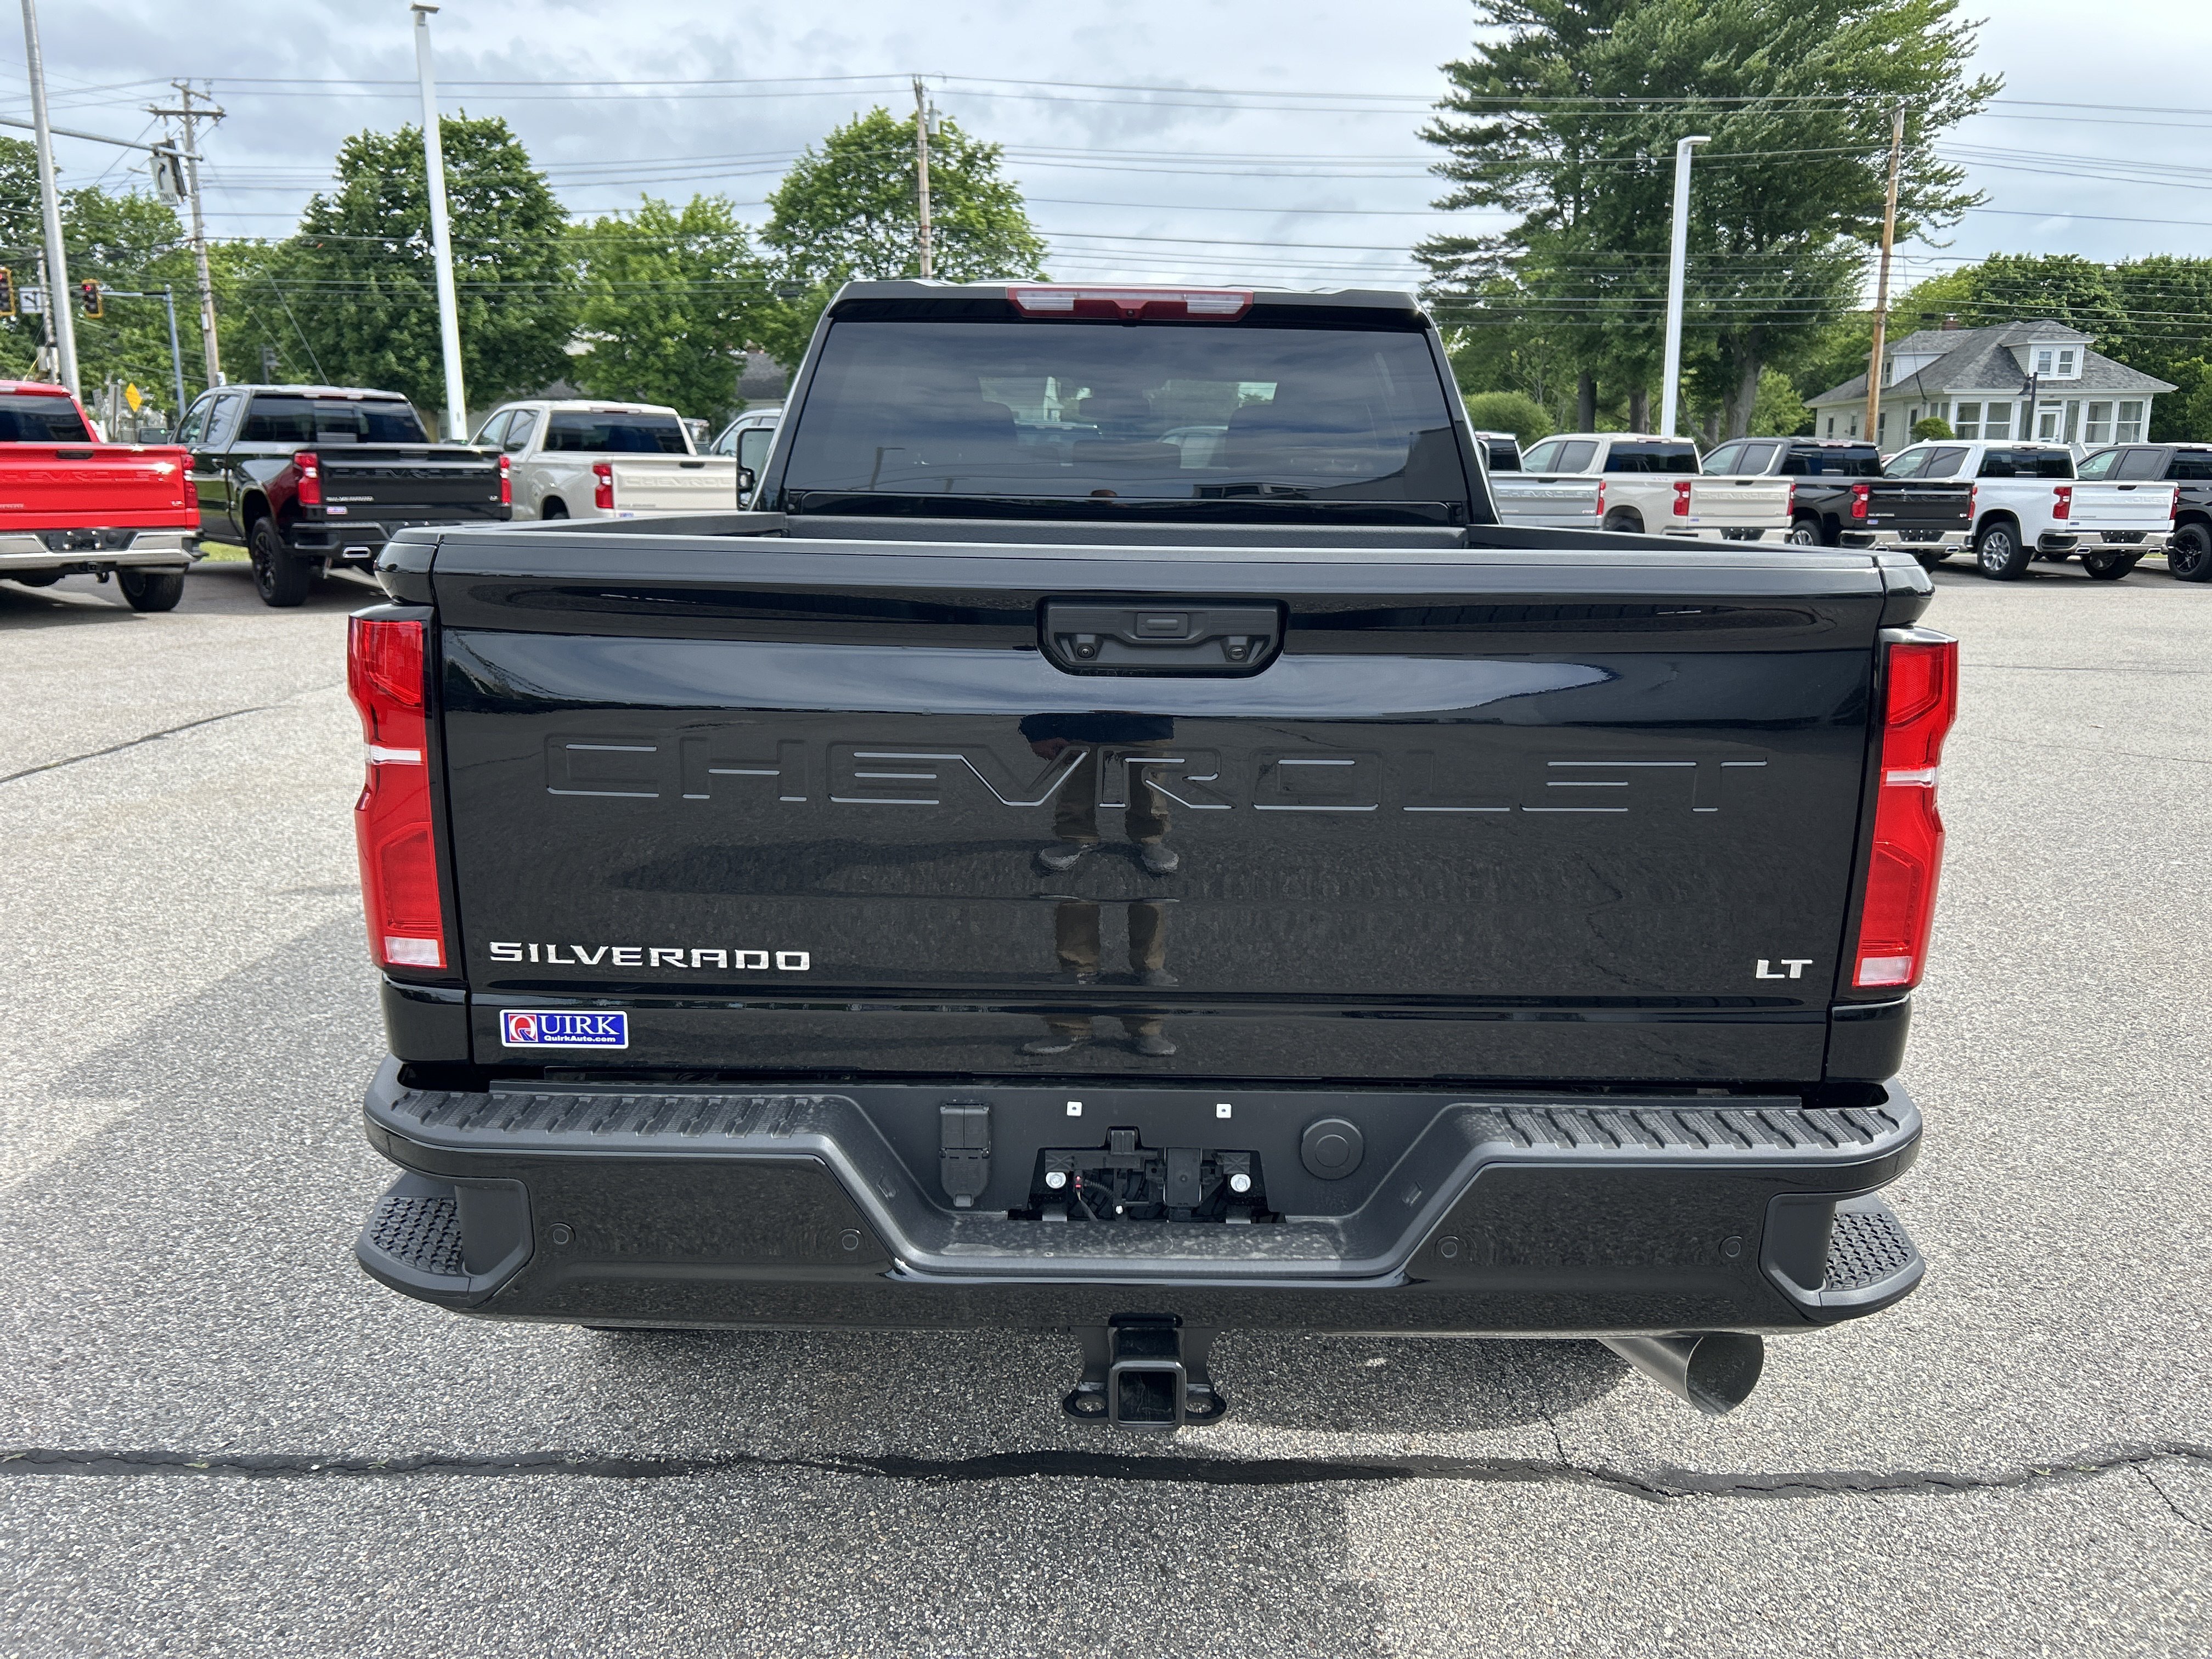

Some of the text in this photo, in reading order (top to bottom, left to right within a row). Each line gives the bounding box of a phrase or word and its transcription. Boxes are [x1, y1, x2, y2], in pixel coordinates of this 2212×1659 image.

[160, 192, 176, 202] ONLY
[544, 733, 1768, 814] CHEVROLET
[489, 941, 810, 970] SILVERADO
[1755, 959, 1813, 979] LT
[509, 1014, 620, 1042] QUIRK
